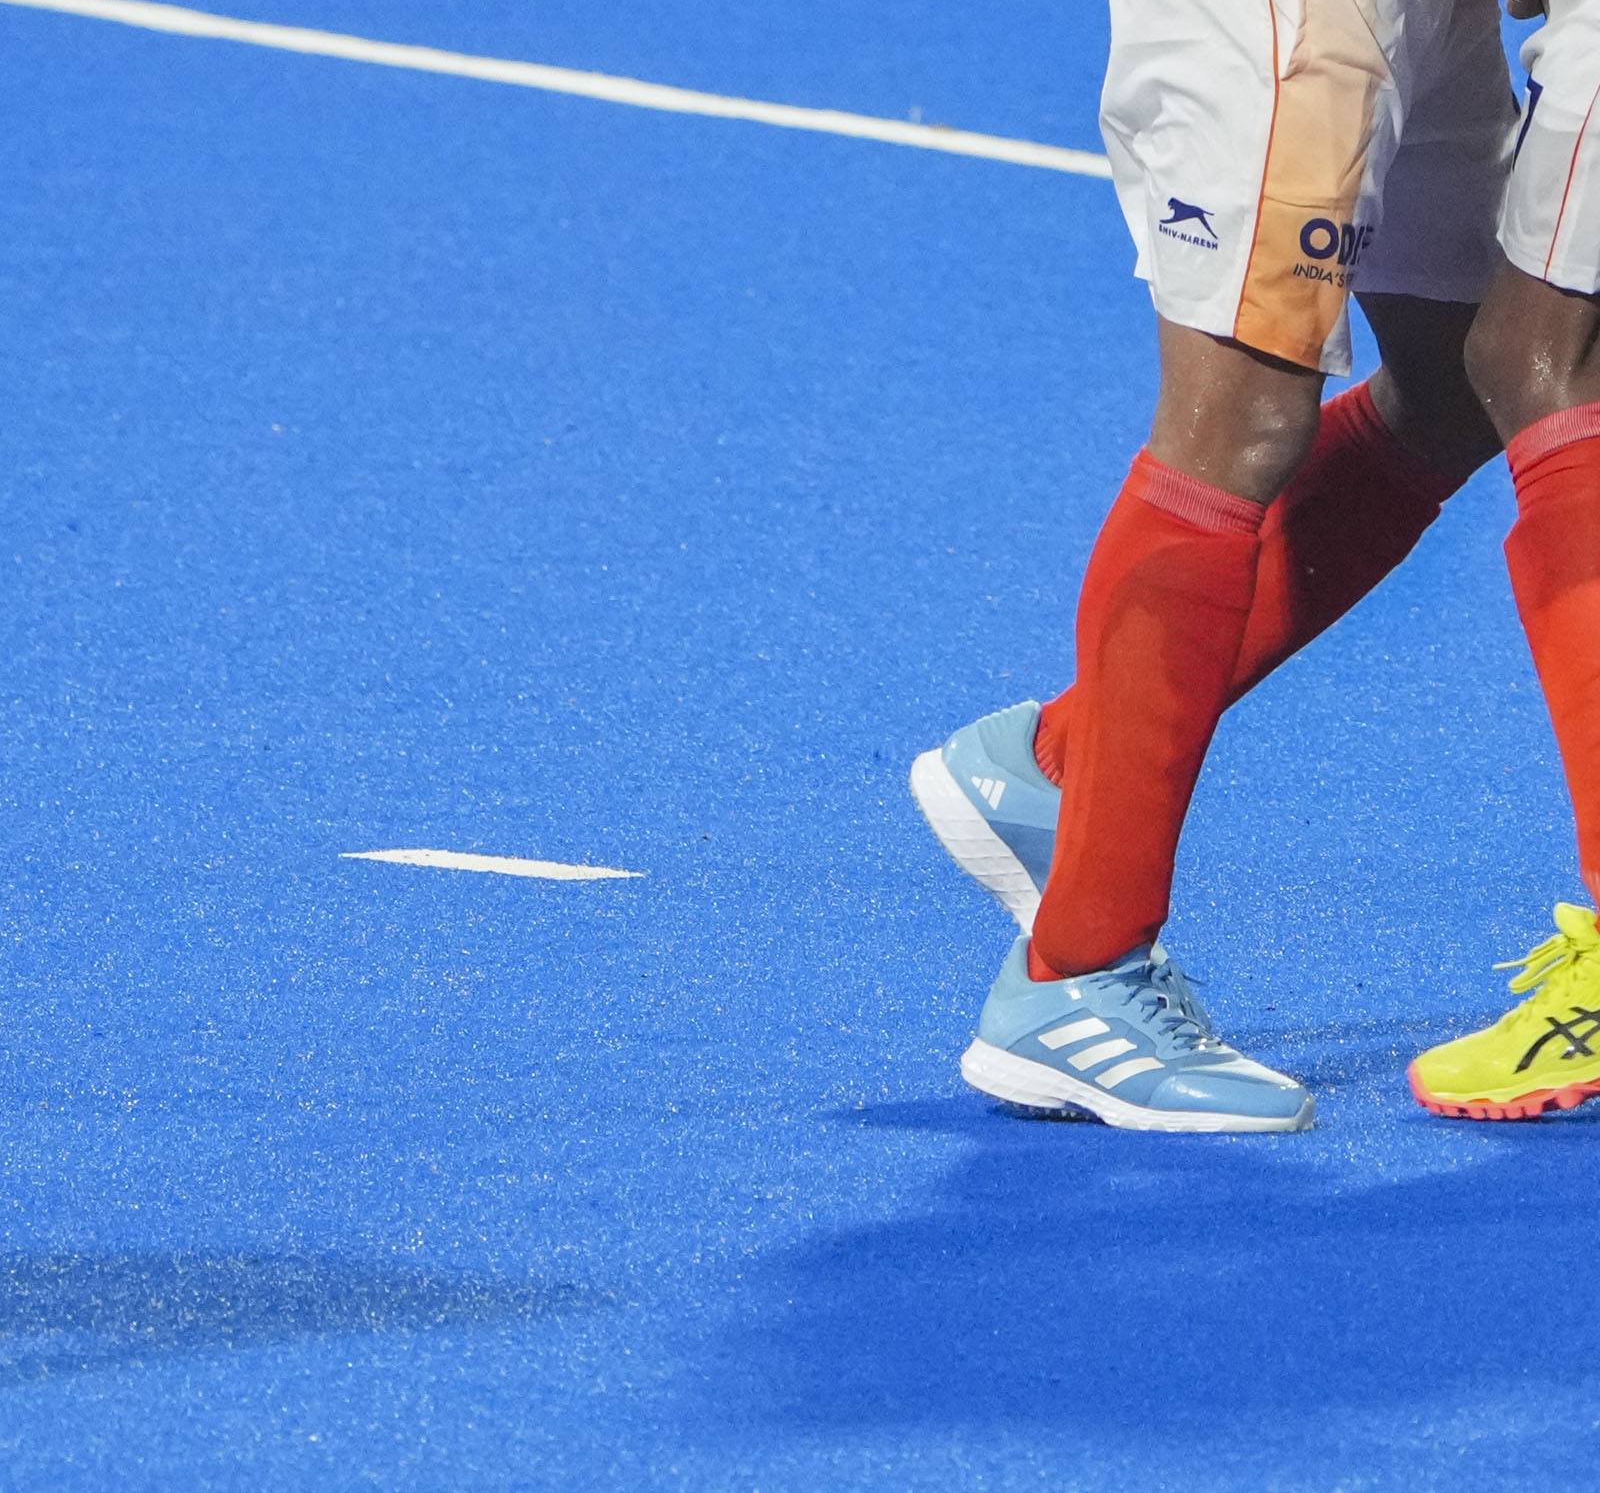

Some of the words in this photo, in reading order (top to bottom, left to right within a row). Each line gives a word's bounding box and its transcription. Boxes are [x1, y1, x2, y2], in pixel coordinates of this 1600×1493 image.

[1158, 223, 1218, 250] SHIV-NARESH
[1300, 218, 1374, 266] ODI
[1293, 263, 1345, 288] INDIA'S
